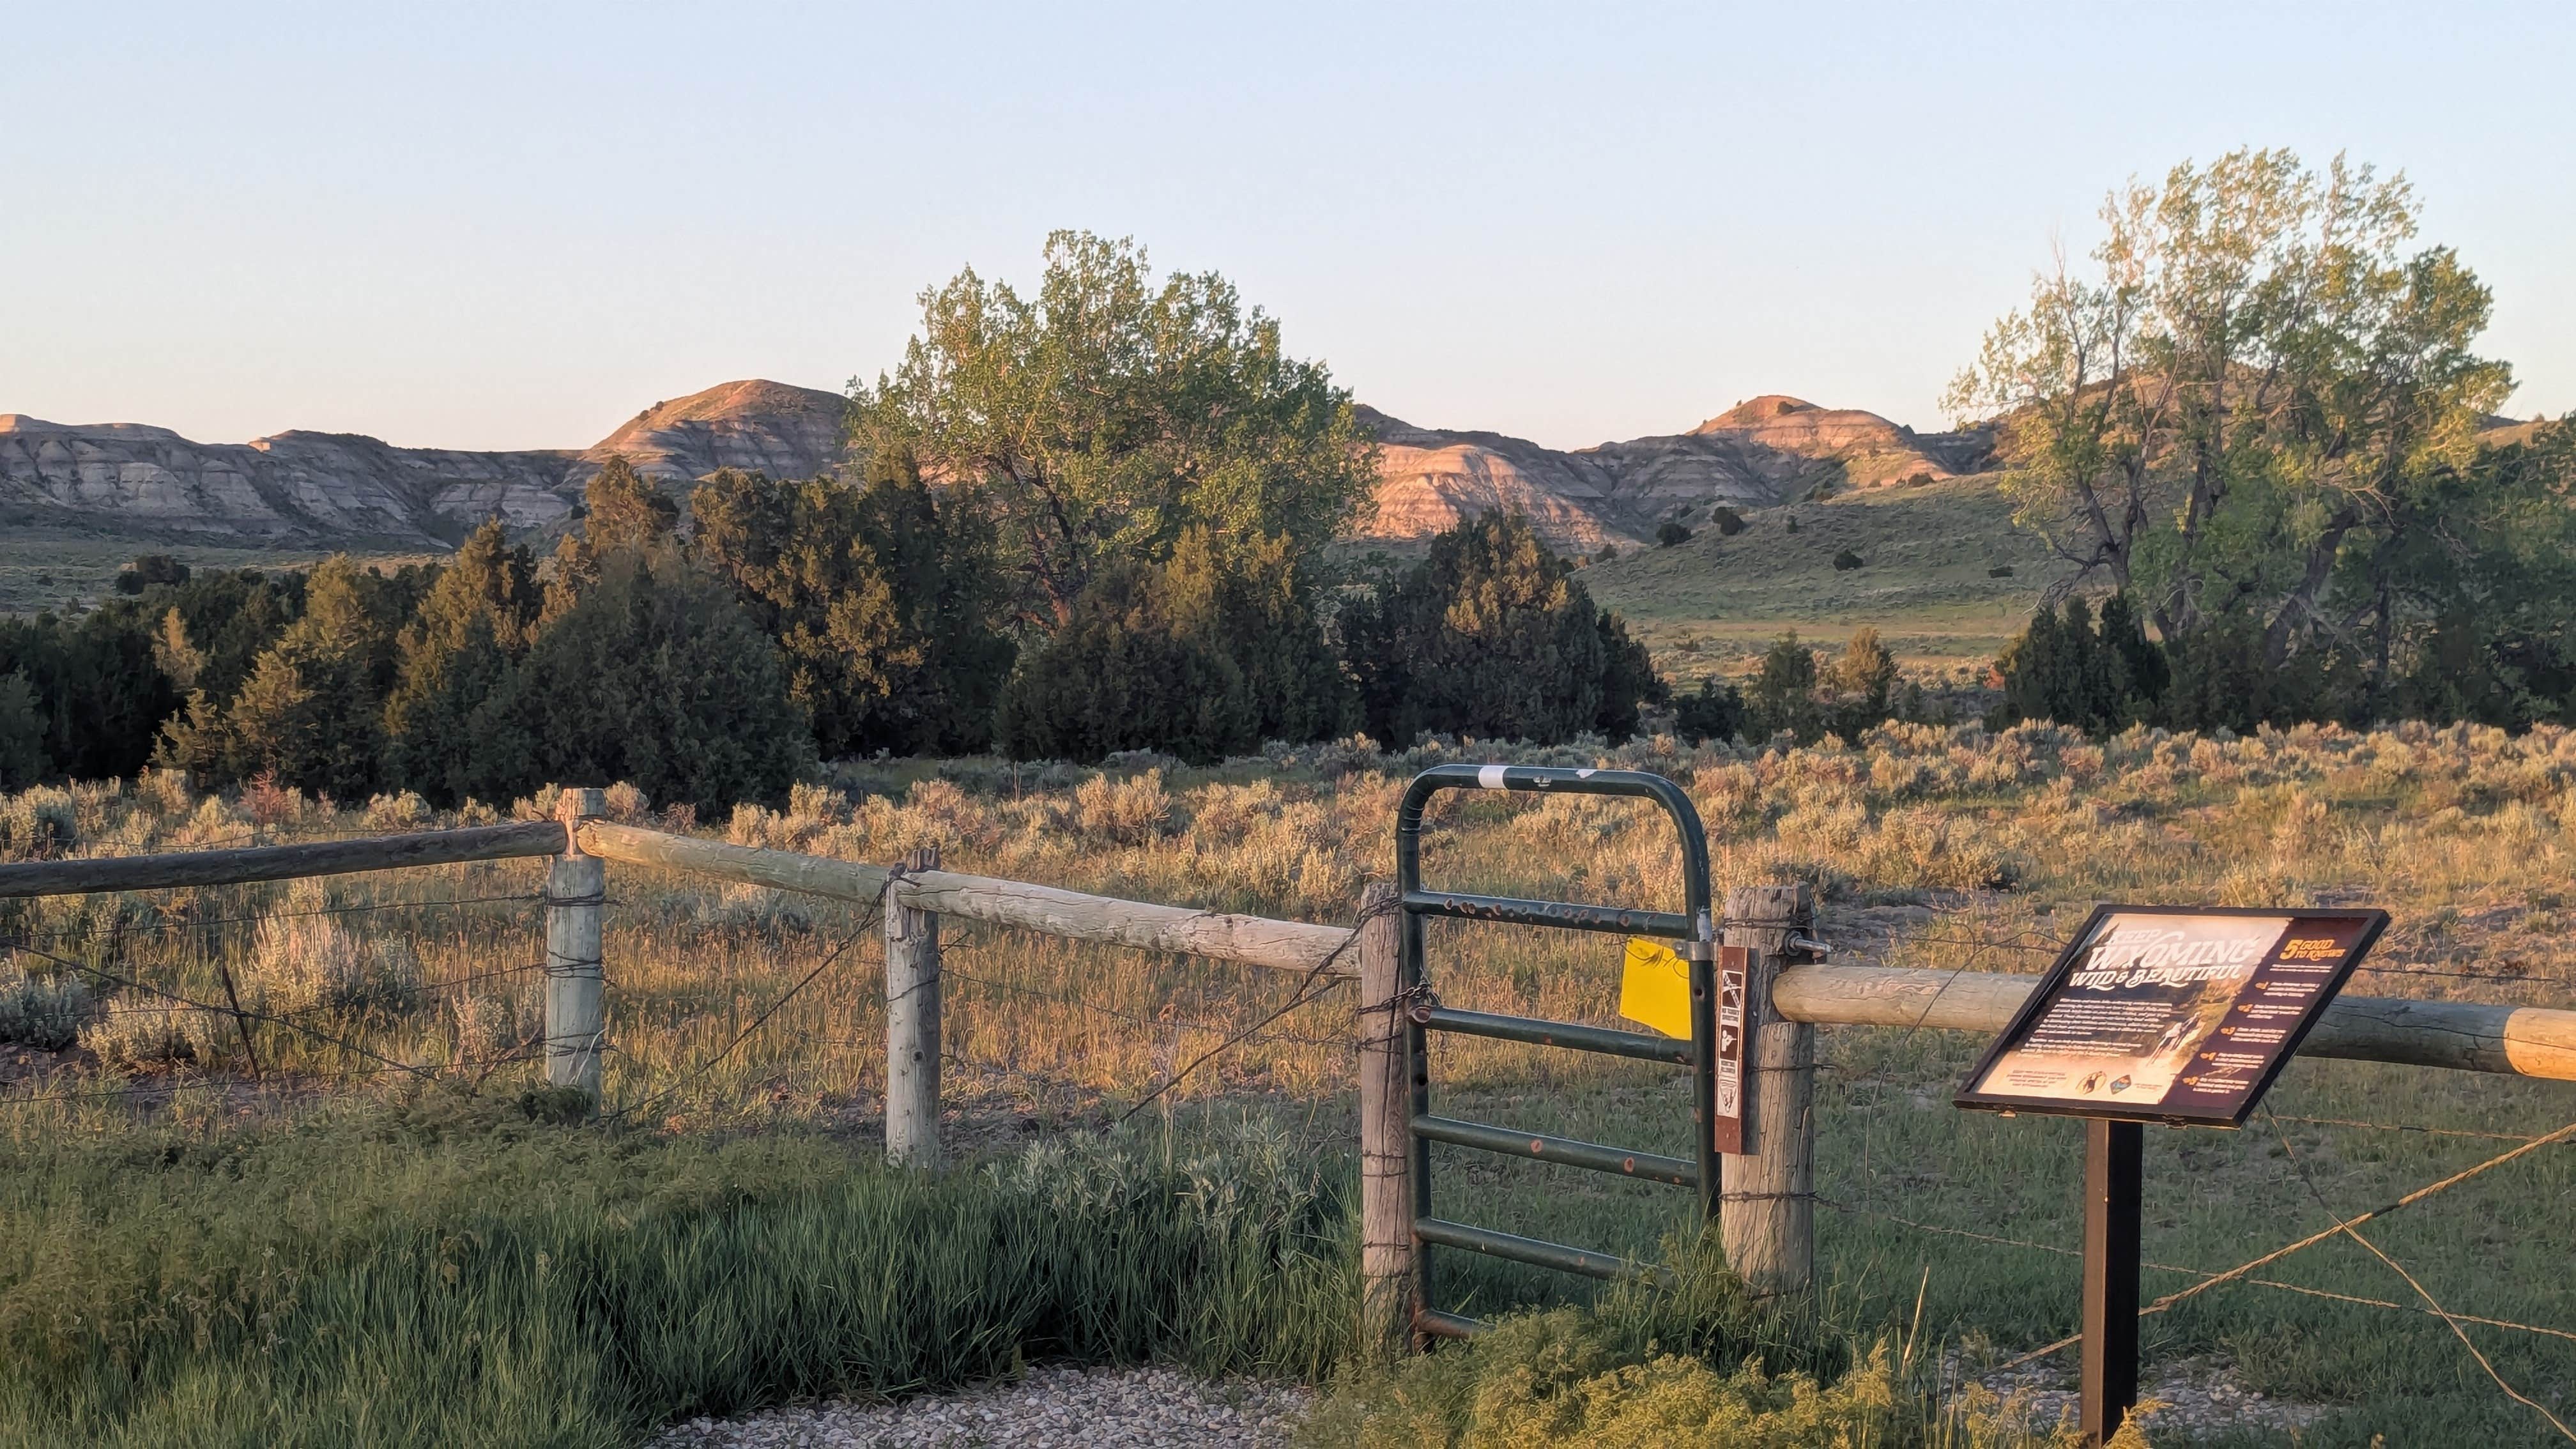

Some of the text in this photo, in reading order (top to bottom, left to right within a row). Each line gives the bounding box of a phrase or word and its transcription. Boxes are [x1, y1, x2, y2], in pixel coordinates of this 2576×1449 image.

[2107, 929, 2161, 944] KEEP
[2085, 931, 2260, 970] WYOMING
[2280, 939, 2335, 960] 5 GOOD
[2295, 950, 2308, 959] TO
[2069, 963, 2243, 991] WILD & BEAUTIFUL
